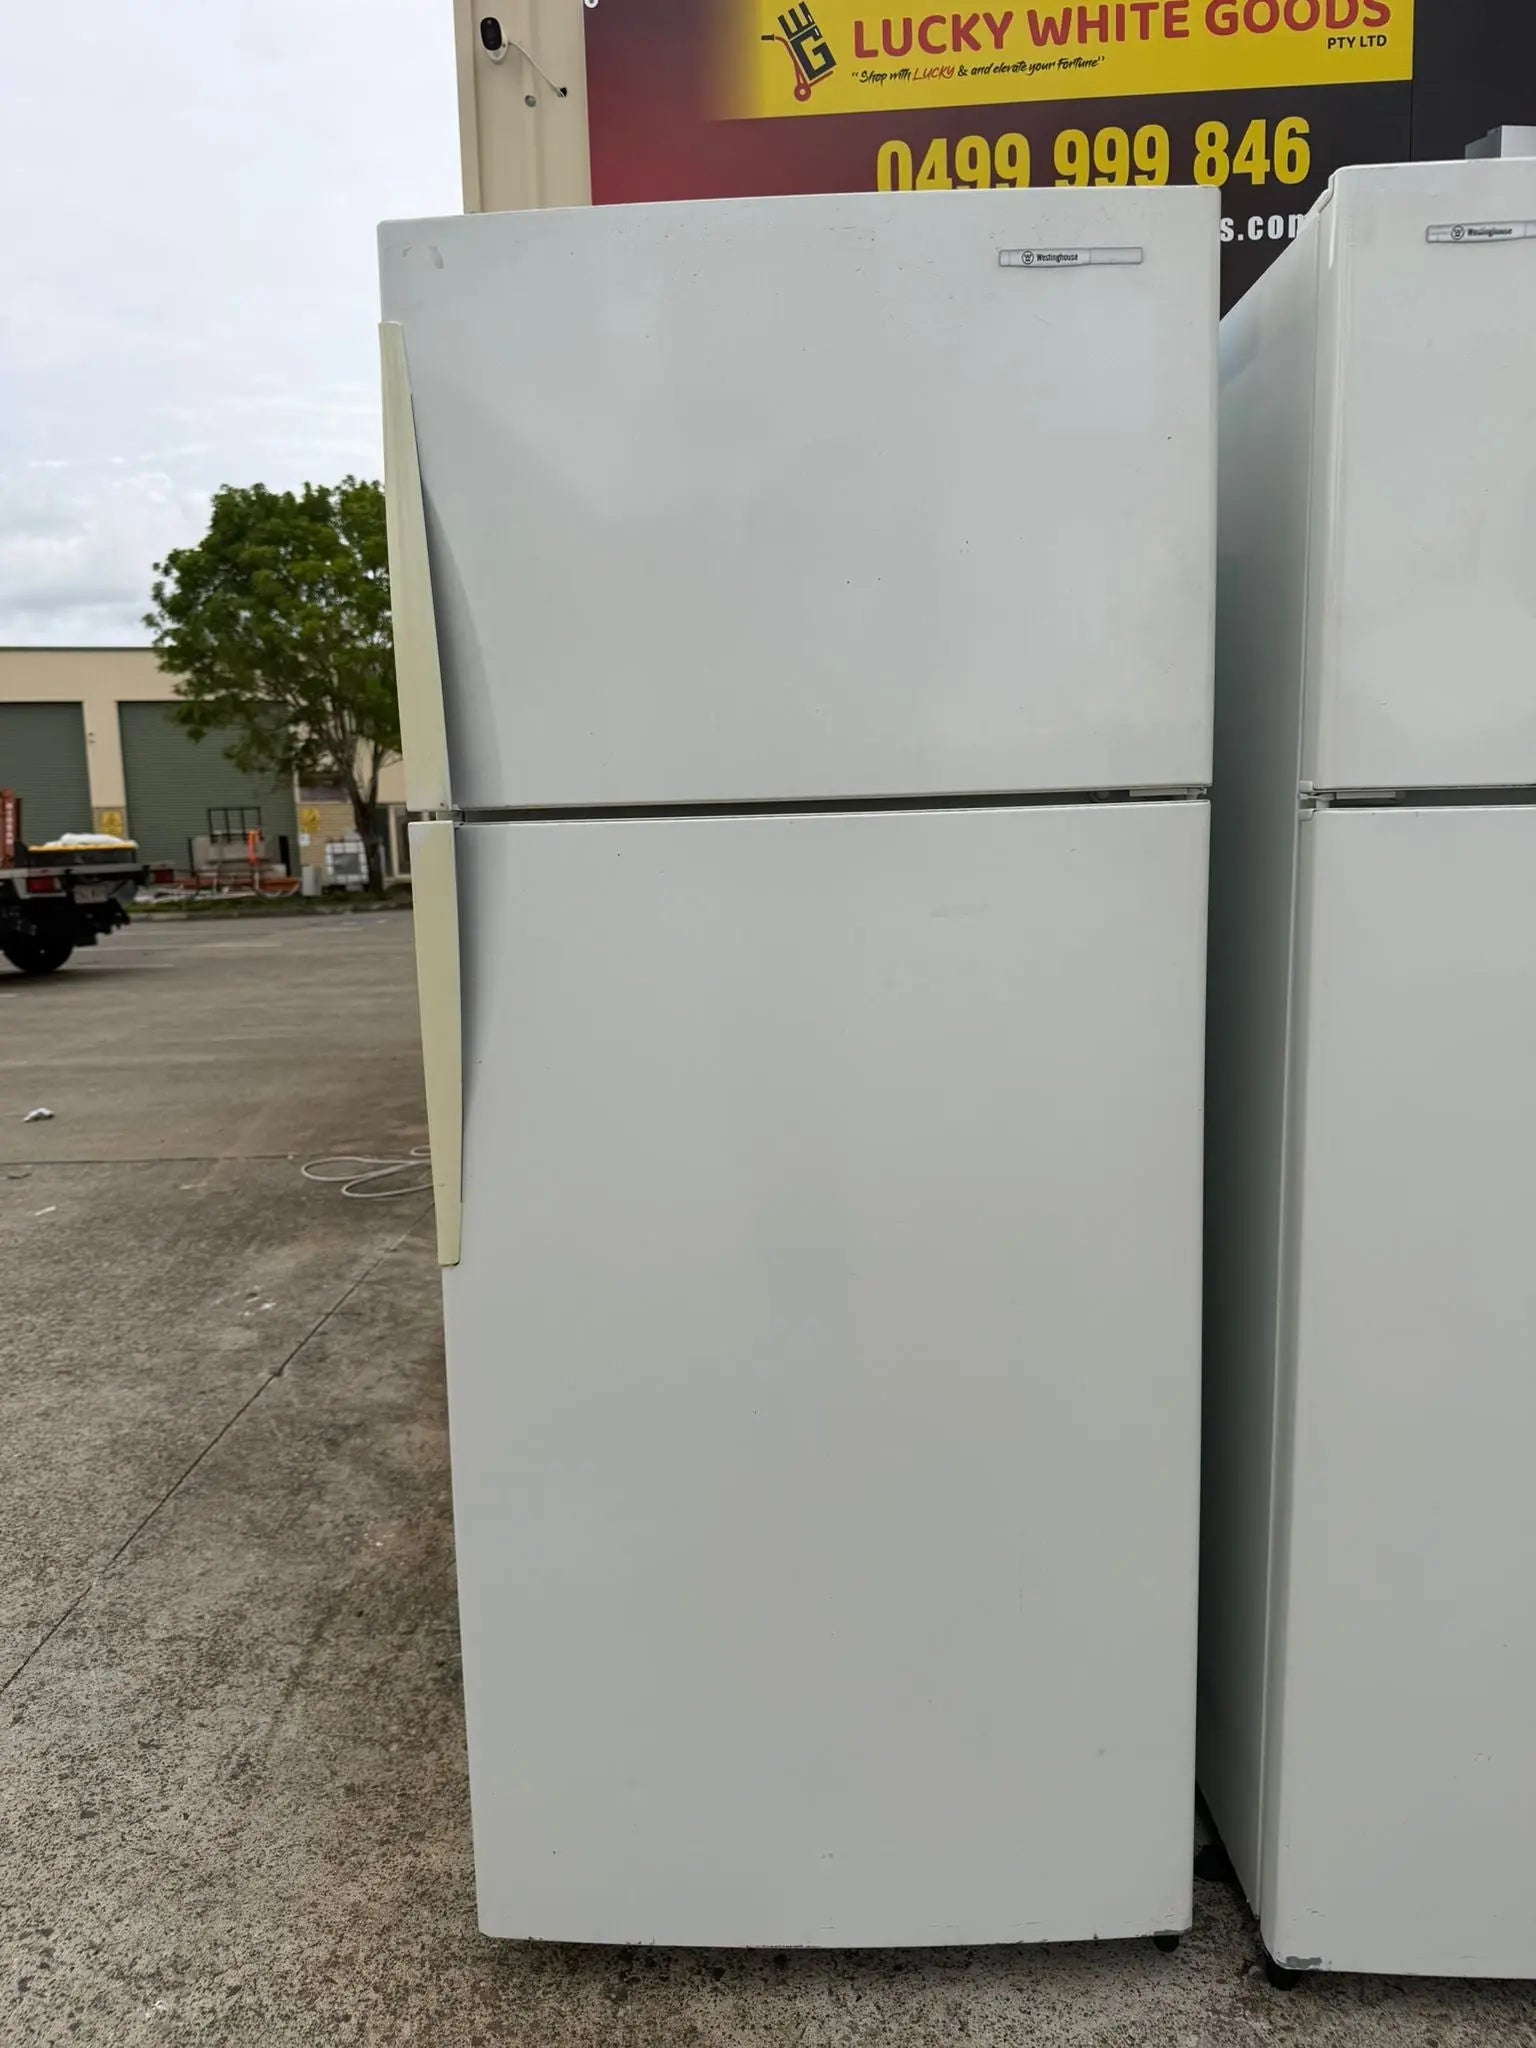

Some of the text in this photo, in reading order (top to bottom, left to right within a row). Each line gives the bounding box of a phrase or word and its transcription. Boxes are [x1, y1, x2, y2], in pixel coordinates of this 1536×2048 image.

[854, 0, 1391, 58] LUCKY WHITE GOODS
[1327, 34, 1387, 49] PTY LTD
[957, 66, 968, 77] &
[970, 62, 993, 76] and
[992, 60, 1027, 74] elevate
[1028, 60, 1056, 77] your
[877, 116, 1311, 193] 0499 999 846
[1036, 253, 1079, 264] Westinghouse
